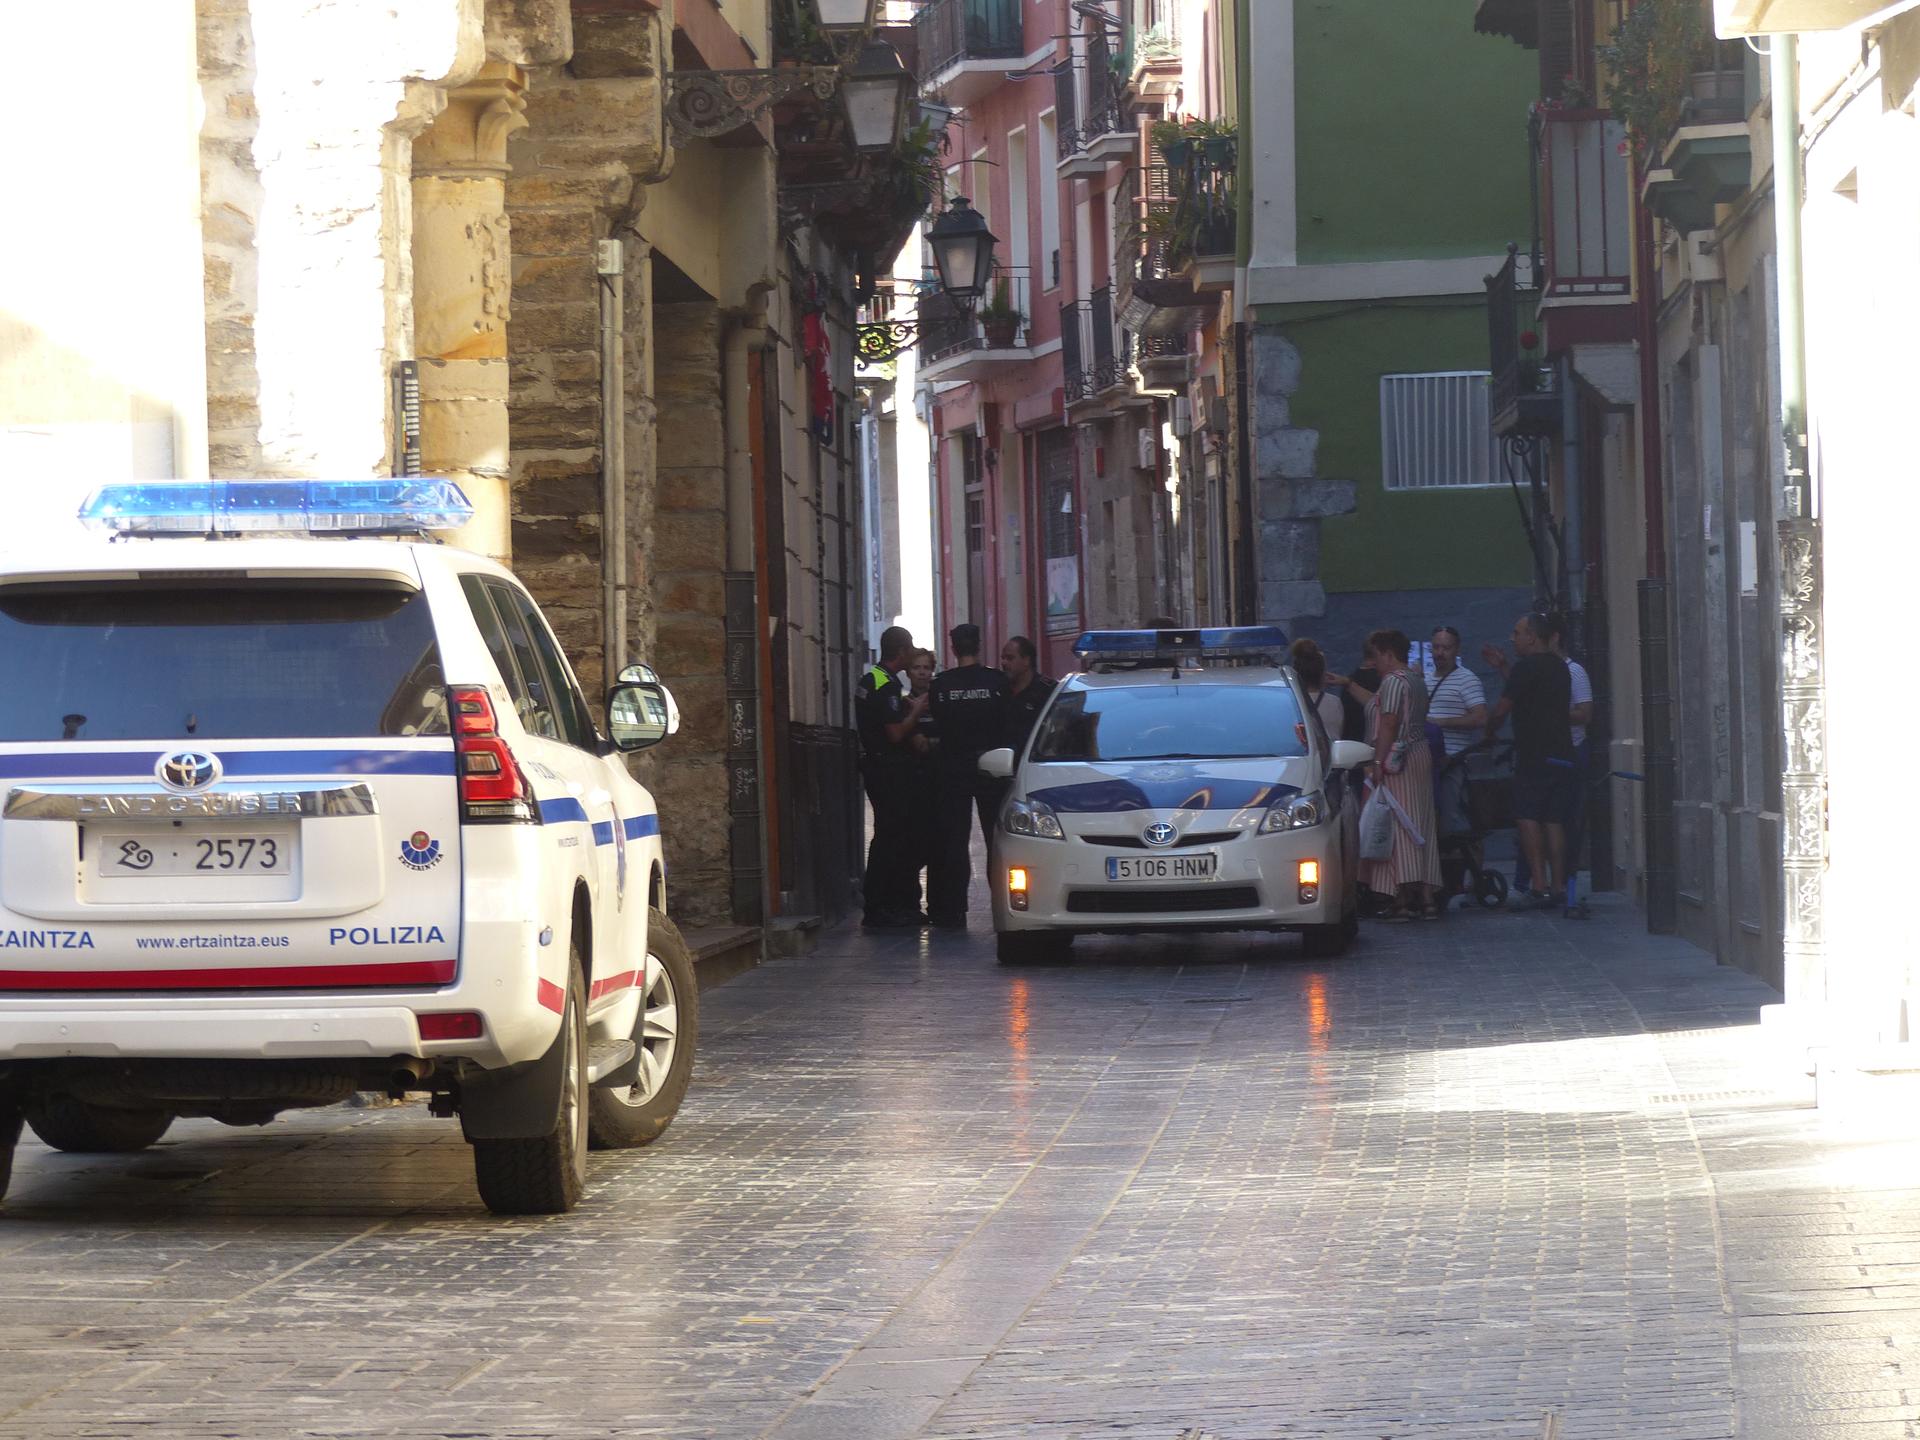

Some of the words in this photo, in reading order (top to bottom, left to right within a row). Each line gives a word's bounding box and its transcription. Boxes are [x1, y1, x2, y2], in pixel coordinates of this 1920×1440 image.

[195, 838, 278, 870] 2573
[1120, 860, 1167, 878] 5106
[1173, 858, 1209, 877] HNM
[0, 930, 95, 949] AINTZA
[136, 934, 290, 949] www.ertzaintza.eus
[329, 925, 446, 946] POLIZIA
